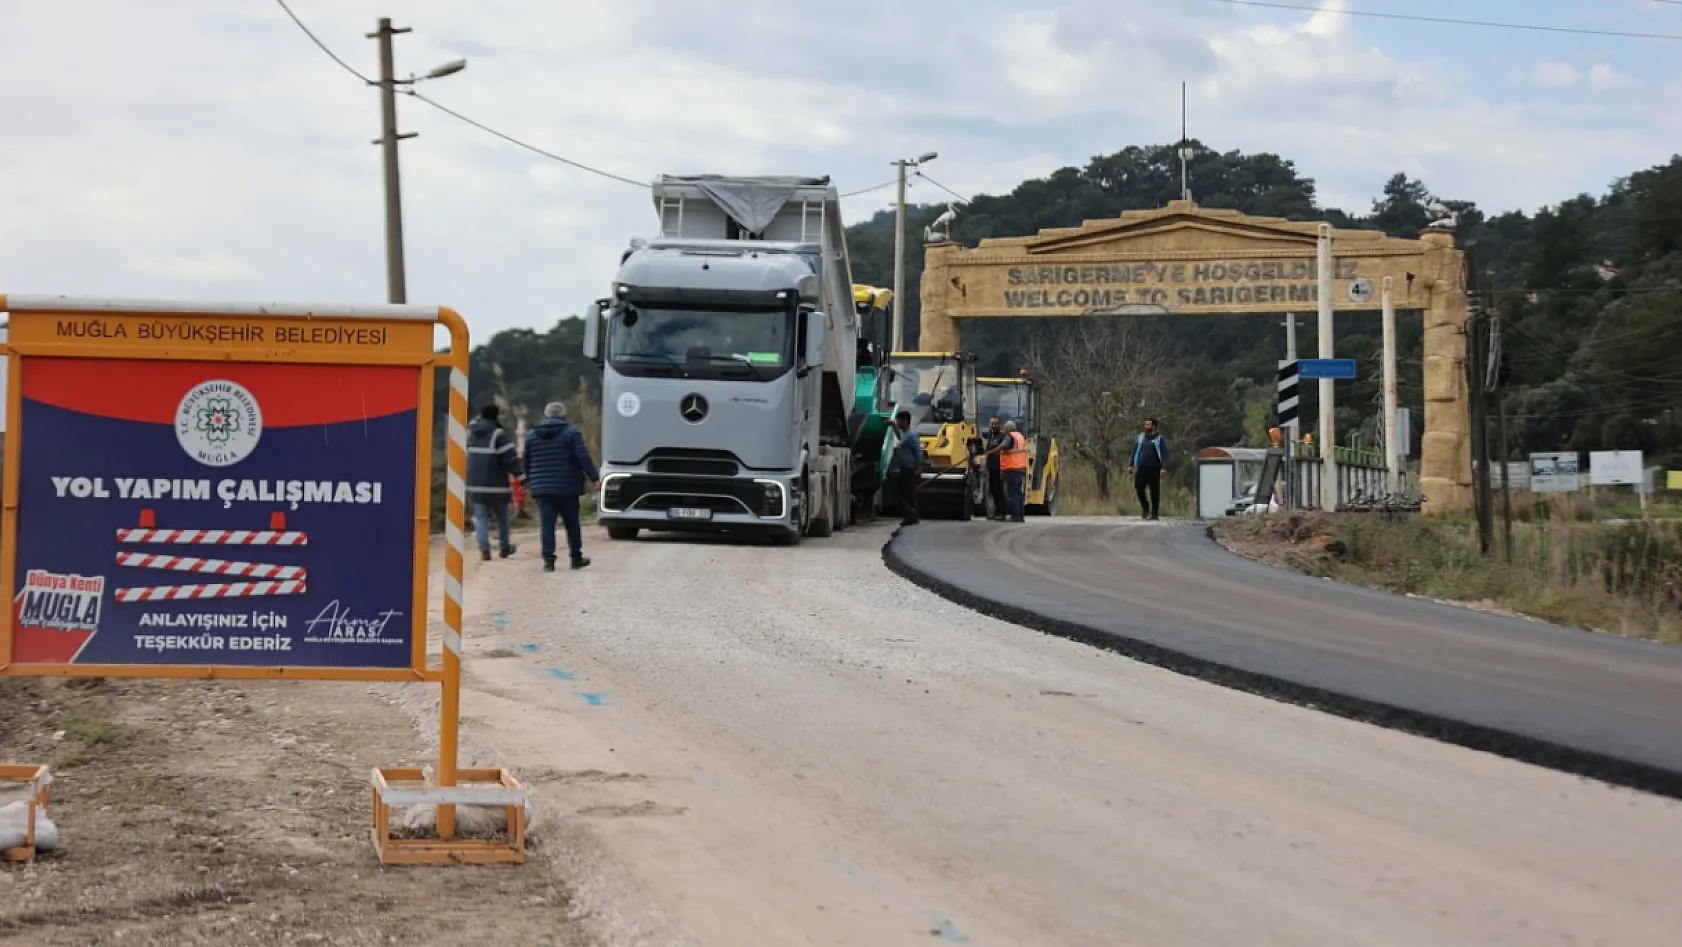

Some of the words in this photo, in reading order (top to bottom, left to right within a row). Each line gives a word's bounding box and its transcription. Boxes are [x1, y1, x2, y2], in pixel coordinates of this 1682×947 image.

[1004, 289, 1127, 308] WELCOME
[1135, 286, 1168, 304] TO
[56, 320, 127, 338] MUĞLA
[138, 321, 264, 344] BÜYÜKŞEHİR
[275, 326, 386, 345] BELEDİYESİ
[51, 477, 110, 498] YOL
[114, 478, 211, 500] YAPIM
[216, 478, 382, 511] ÇALIŞMASI
[29, 572, 67, 590] Dünya
[139, 612, 248, 631] ANLAYIŞINIZ
[252, 610, 288, 632] İÇİN
[304, 599, 404, 637] Ahmet
[134, 633, 225, 653] TEŞEKKÜR
[229, 633, 292, 650] EDERİZ
[333, 626, 377, 638] ARAS
